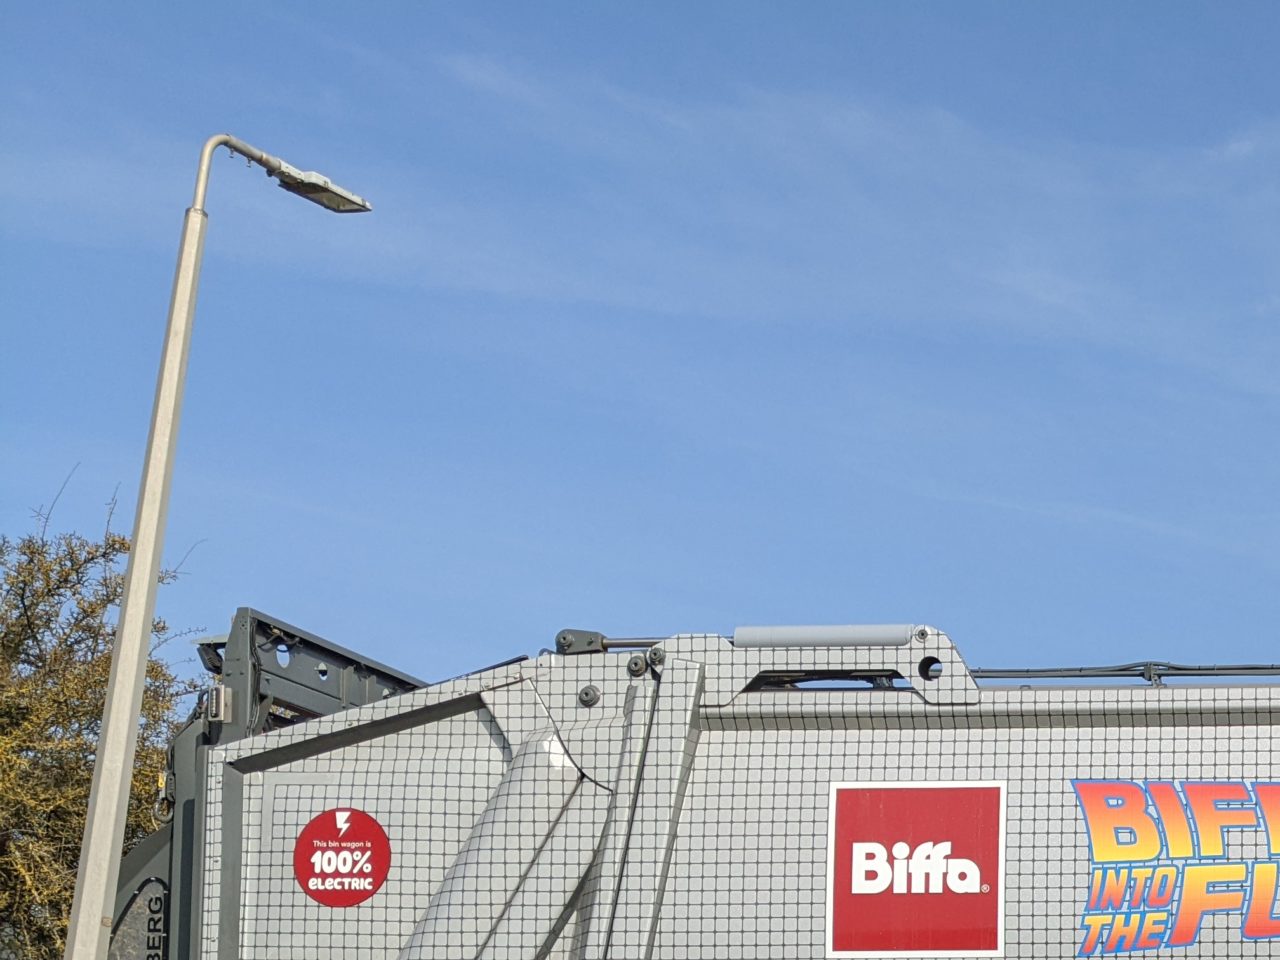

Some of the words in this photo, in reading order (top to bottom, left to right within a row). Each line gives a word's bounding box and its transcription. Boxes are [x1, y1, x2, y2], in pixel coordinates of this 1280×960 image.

[312, 840, 327, 848] This
[328, 840, 340, 848] bin
[365, 840, 372, 848] is
[310, 850, 372, 874] 100%
[1084, 864, 1179, 912] INTO
[1075, 911, 1171, 958] THE
